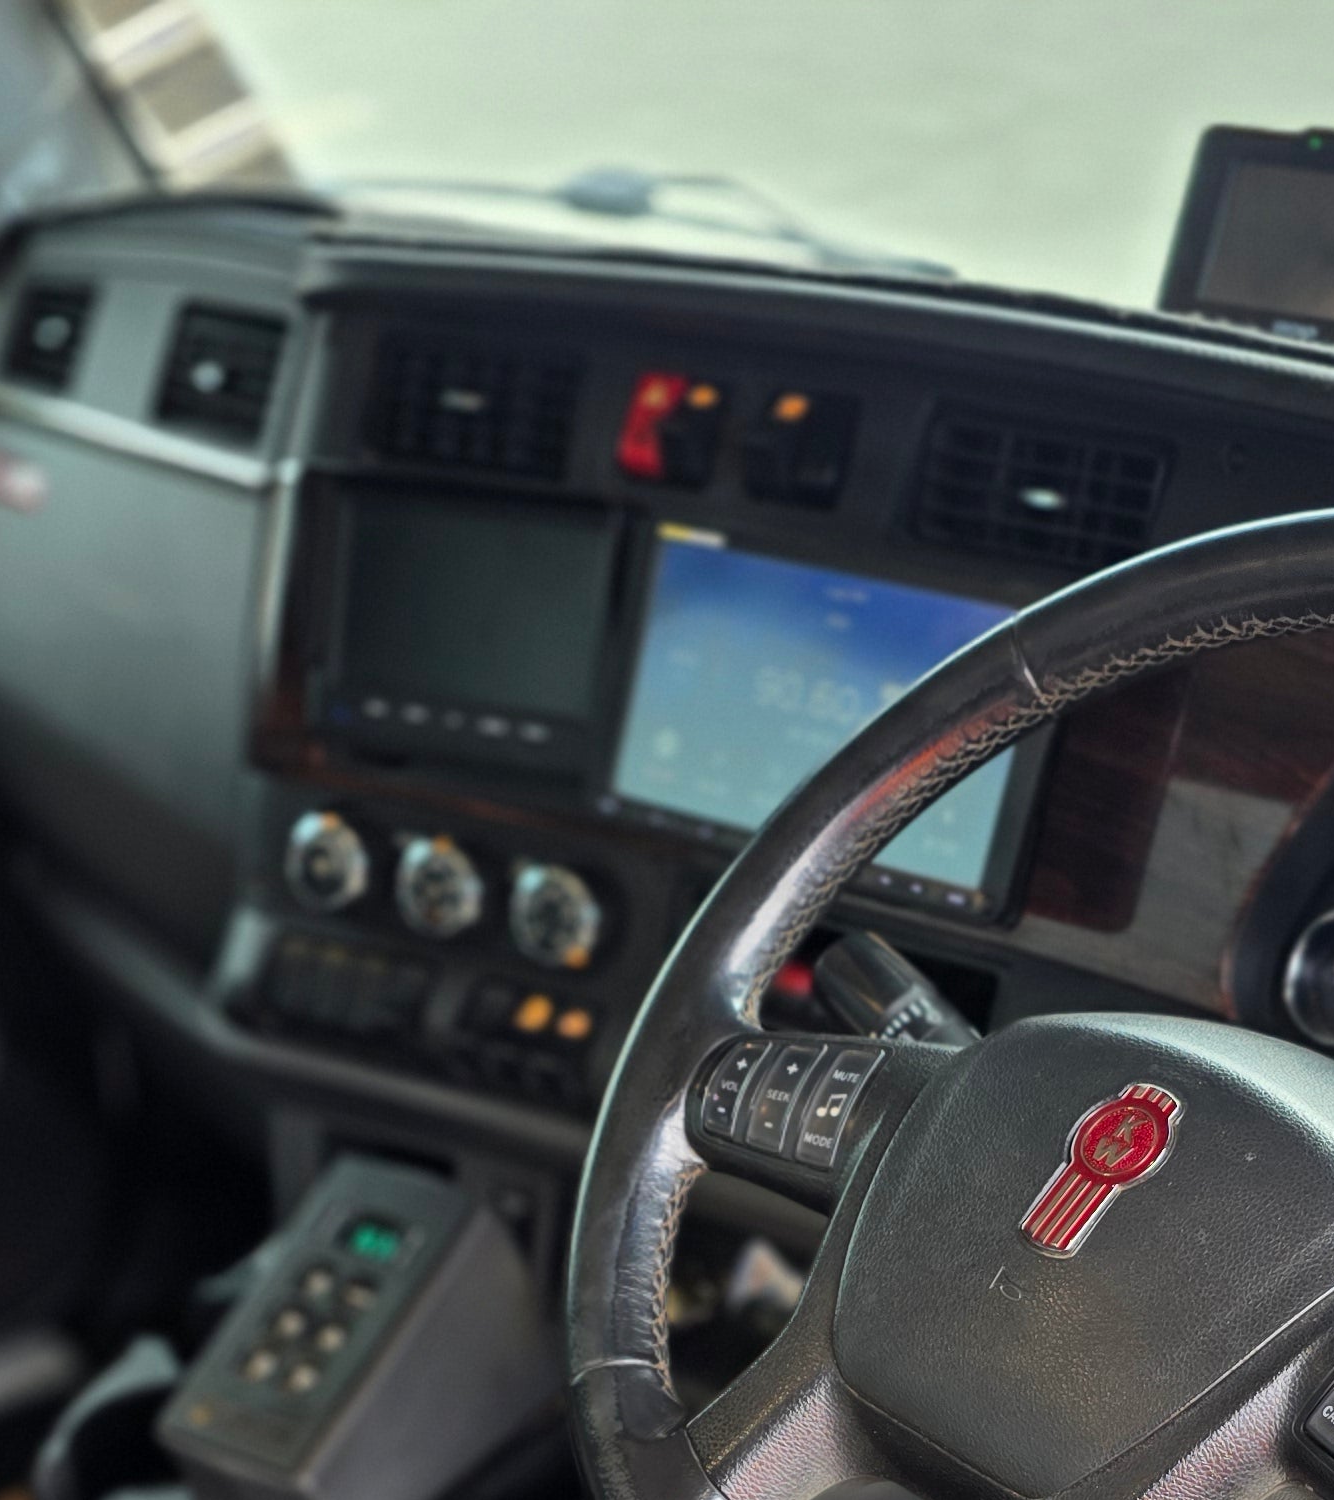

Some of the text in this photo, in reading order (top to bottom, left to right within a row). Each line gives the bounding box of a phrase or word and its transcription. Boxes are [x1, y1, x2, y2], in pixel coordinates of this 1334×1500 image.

[832, 1069, 860, 1083] MUTE
[720, 1079, 739, 1092] VOL
[766, 1089, 791, 1102] SEEK
[803, 1132, 834, 1148] MODE
